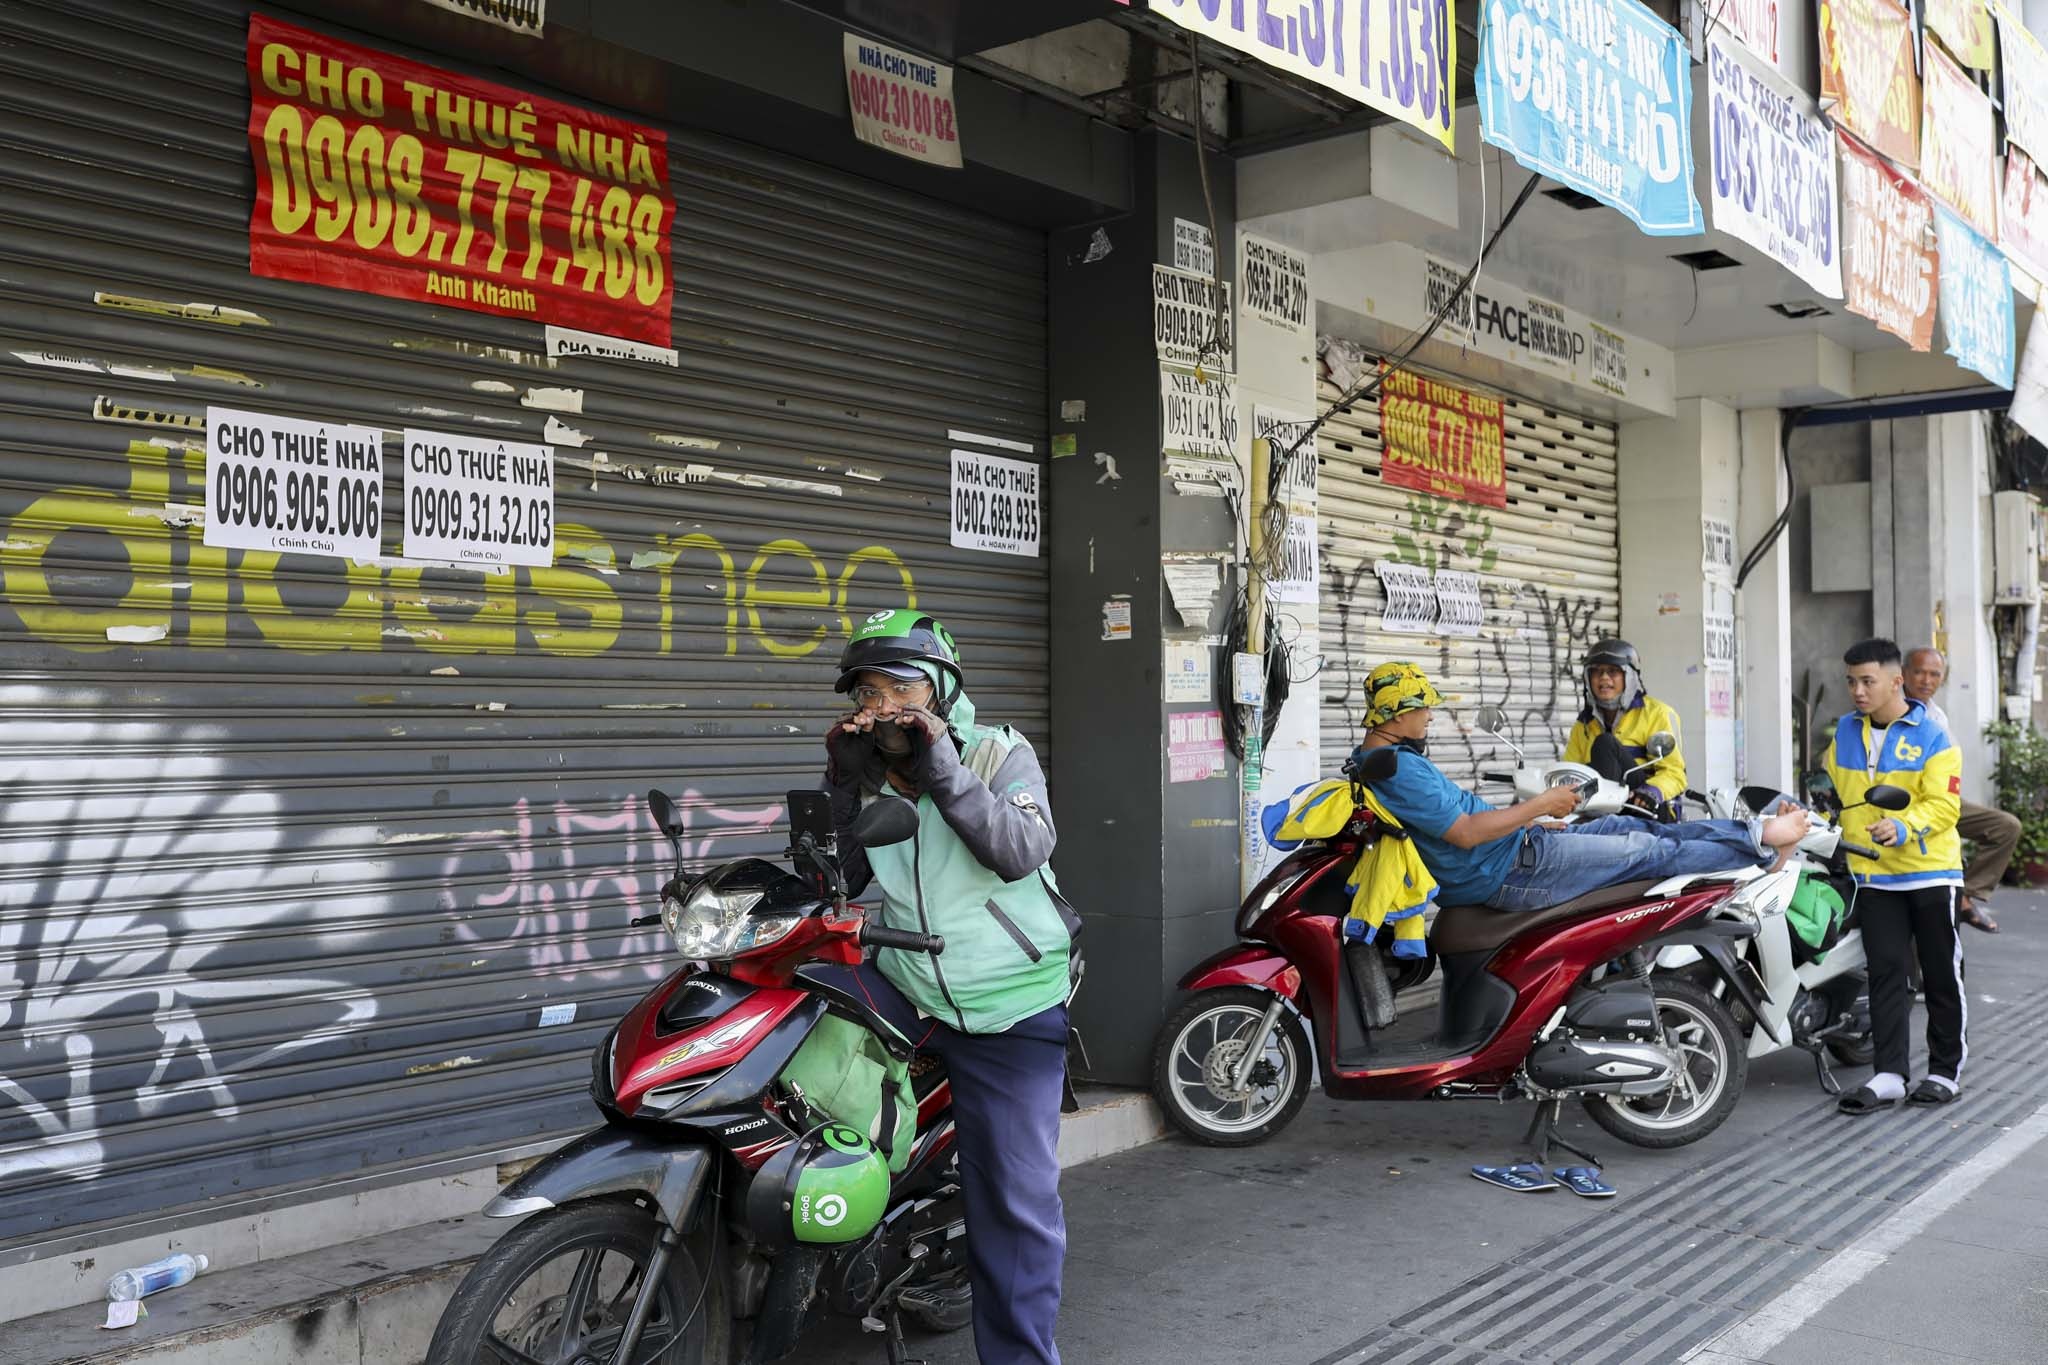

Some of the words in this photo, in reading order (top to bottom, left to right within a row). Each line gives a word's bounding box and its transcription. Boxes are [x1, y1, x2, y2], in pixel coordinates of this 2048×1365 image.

[858, 44, 883, 70] NHÀ
[884, 53, 907, 78] CHO
[908, 61, 937, 88] THUÊ
[262, 42, 385, 119] CHO
[403, 80, 543, 160] THUÊ
[556, 123, 661, 191] NHÀ
[264, 103, 664, 306] 0908.777.488
[1246, 240, 1264, 261] CHO
[426, 271, 467, 301] Anh
[472, 276, 537, 313] Khánh
[1155, 270, 1179, 302] CHO
[1179, 277, 1208, 309] THUÊ
[1476, 294, 1530, 348] FACE
[1168, 394, 1193, 436] 0931
[216, 422, 265, 458] CHO
[271, 428, 329, 467] THUÊ
[336, 435, 380, 473] NHÀ
[410, 442, 452, 473] CHO
[457, 444, 508, 483] THUÊ
[512, 450, 551, 488] NHÀ
[957, 457, 982, 486] NHÀ
[984, 464, 1006, 490] CHO
[1008, 467, 1035, 495] THUÊ
[215, 461, 380, 540] 0906.905.006
[411, 485, 551, 548] 0909.31.32.03
[956, 487, 1038, 542] 0902.689.935
[862, 622, 887, 635] gojek
[1895, 735, 1922, 761] be
[1615, 901, 1675, 923] VISION
[686, 980, 722, 997] HONDA
[725, 1117, 769, 1136] HONDA
[800, 1194, 813, 1225] gojek
